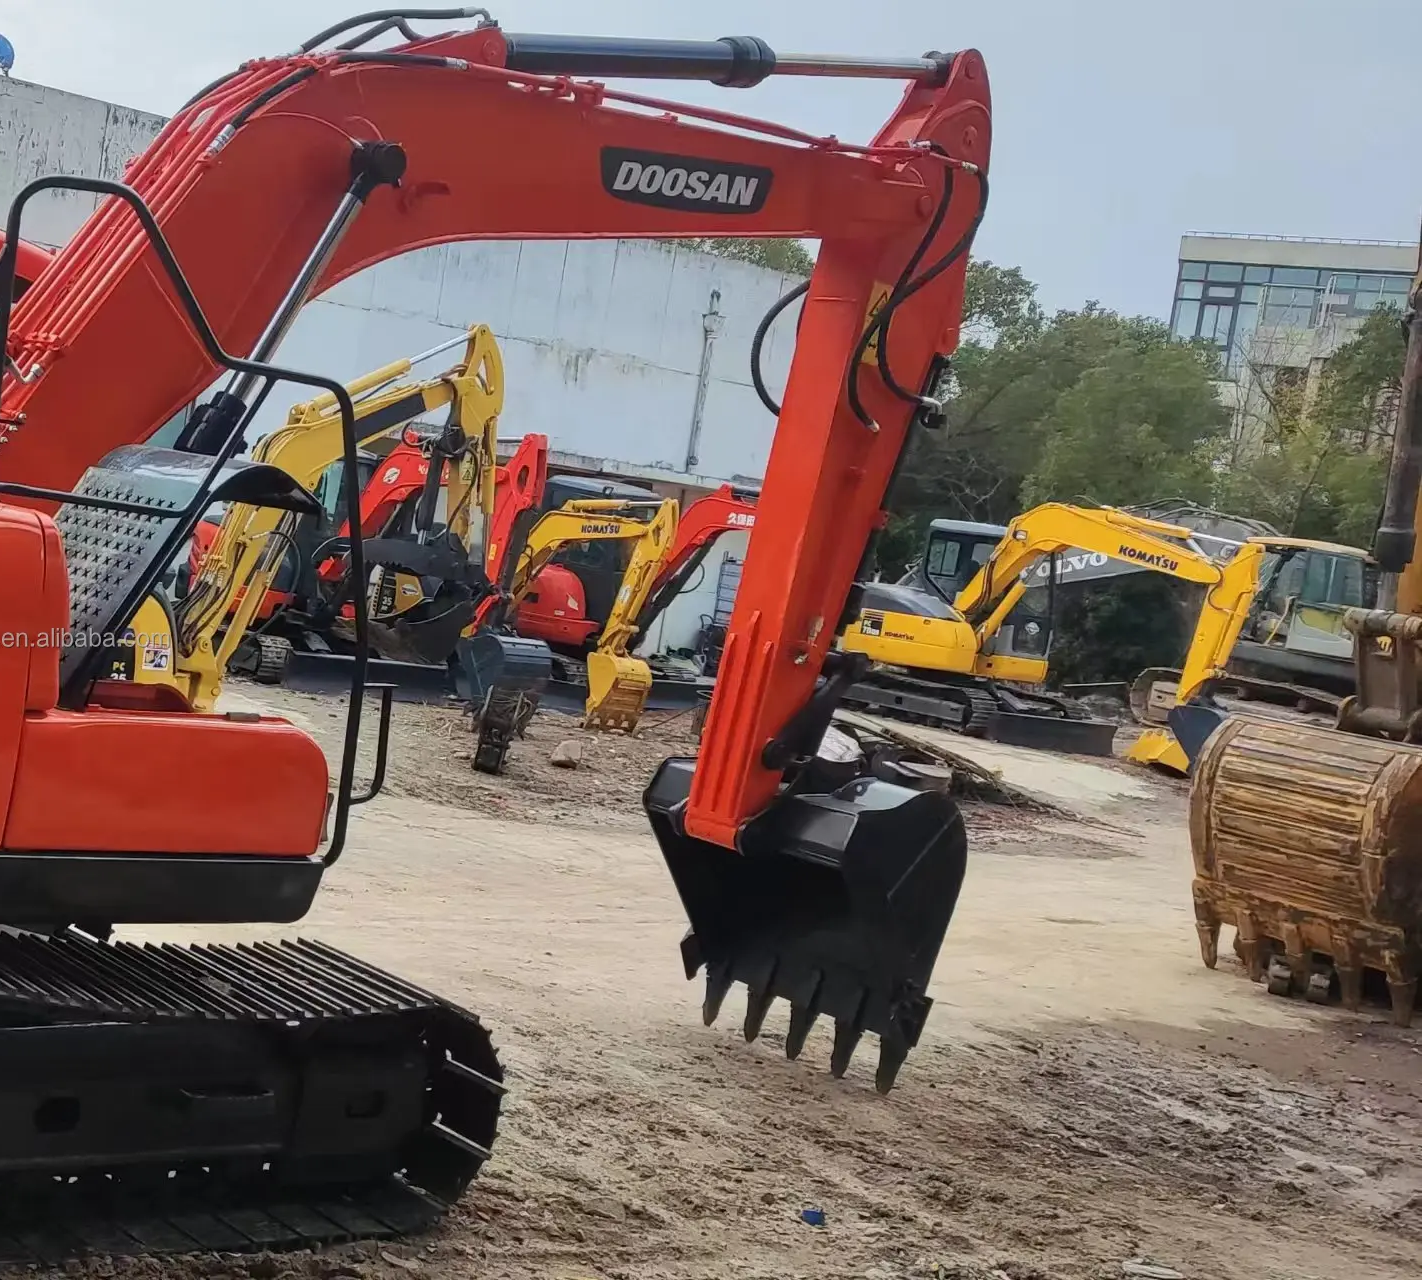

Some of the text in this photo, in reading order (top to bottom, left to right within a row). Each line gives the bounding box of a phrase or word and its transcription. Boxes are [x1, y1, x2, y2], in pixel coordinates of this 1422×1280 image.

[612, 161, 759, 206] DOOSAN
[581, 523, 620, 534] KOMATSU
[1119, 545, 1178, 571] KOMATSU
[112, 661, 126, 672] PC
